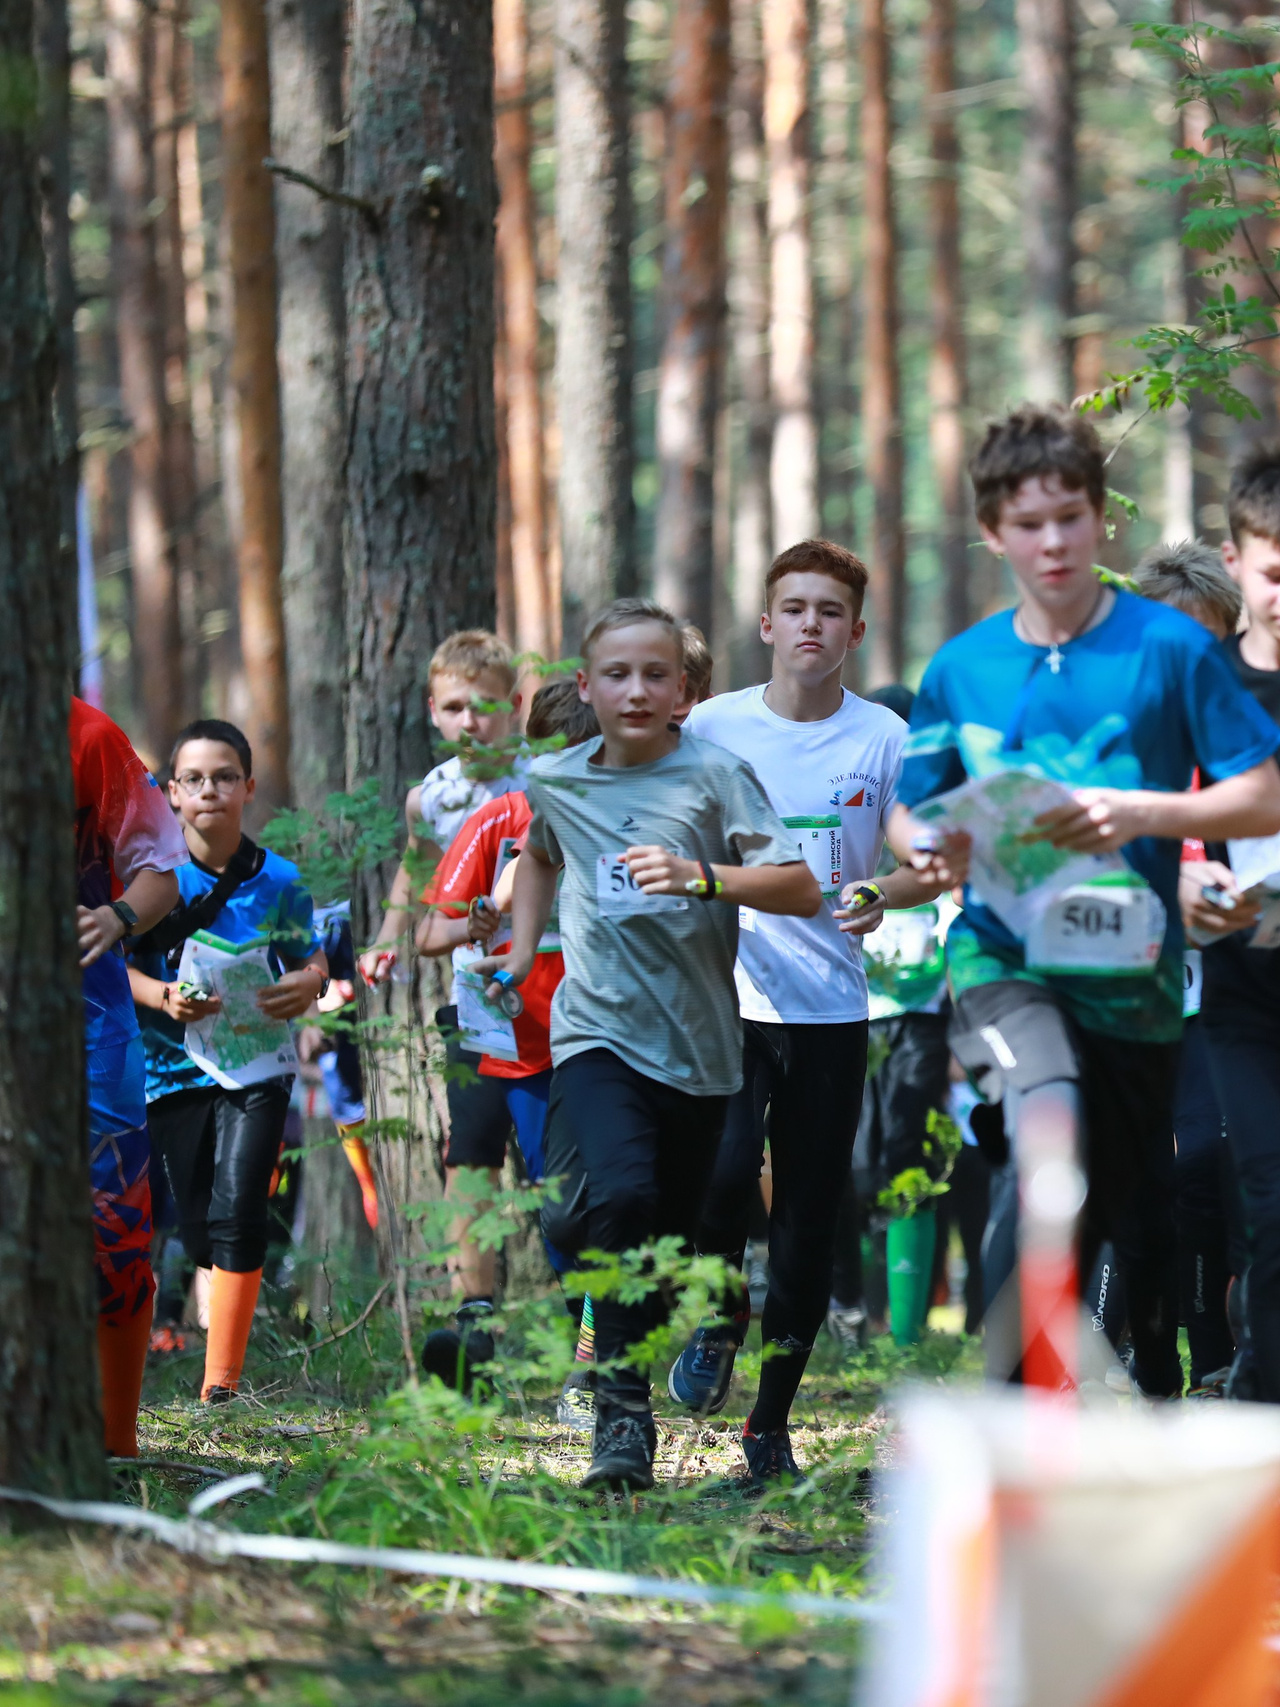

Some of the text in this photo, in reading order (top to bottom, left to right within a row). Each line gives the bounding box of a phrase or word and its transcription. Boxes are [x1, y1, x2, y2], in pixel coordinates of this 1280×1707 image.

[827, 772, 881, 789] ЭДЕЛЬВЕЙС
[828, 830, 836, 870] ПЕРМСКИЙ
[1062, 904, 1123, 936] 504
[1097, 1264, 1110, 1315] NORD
